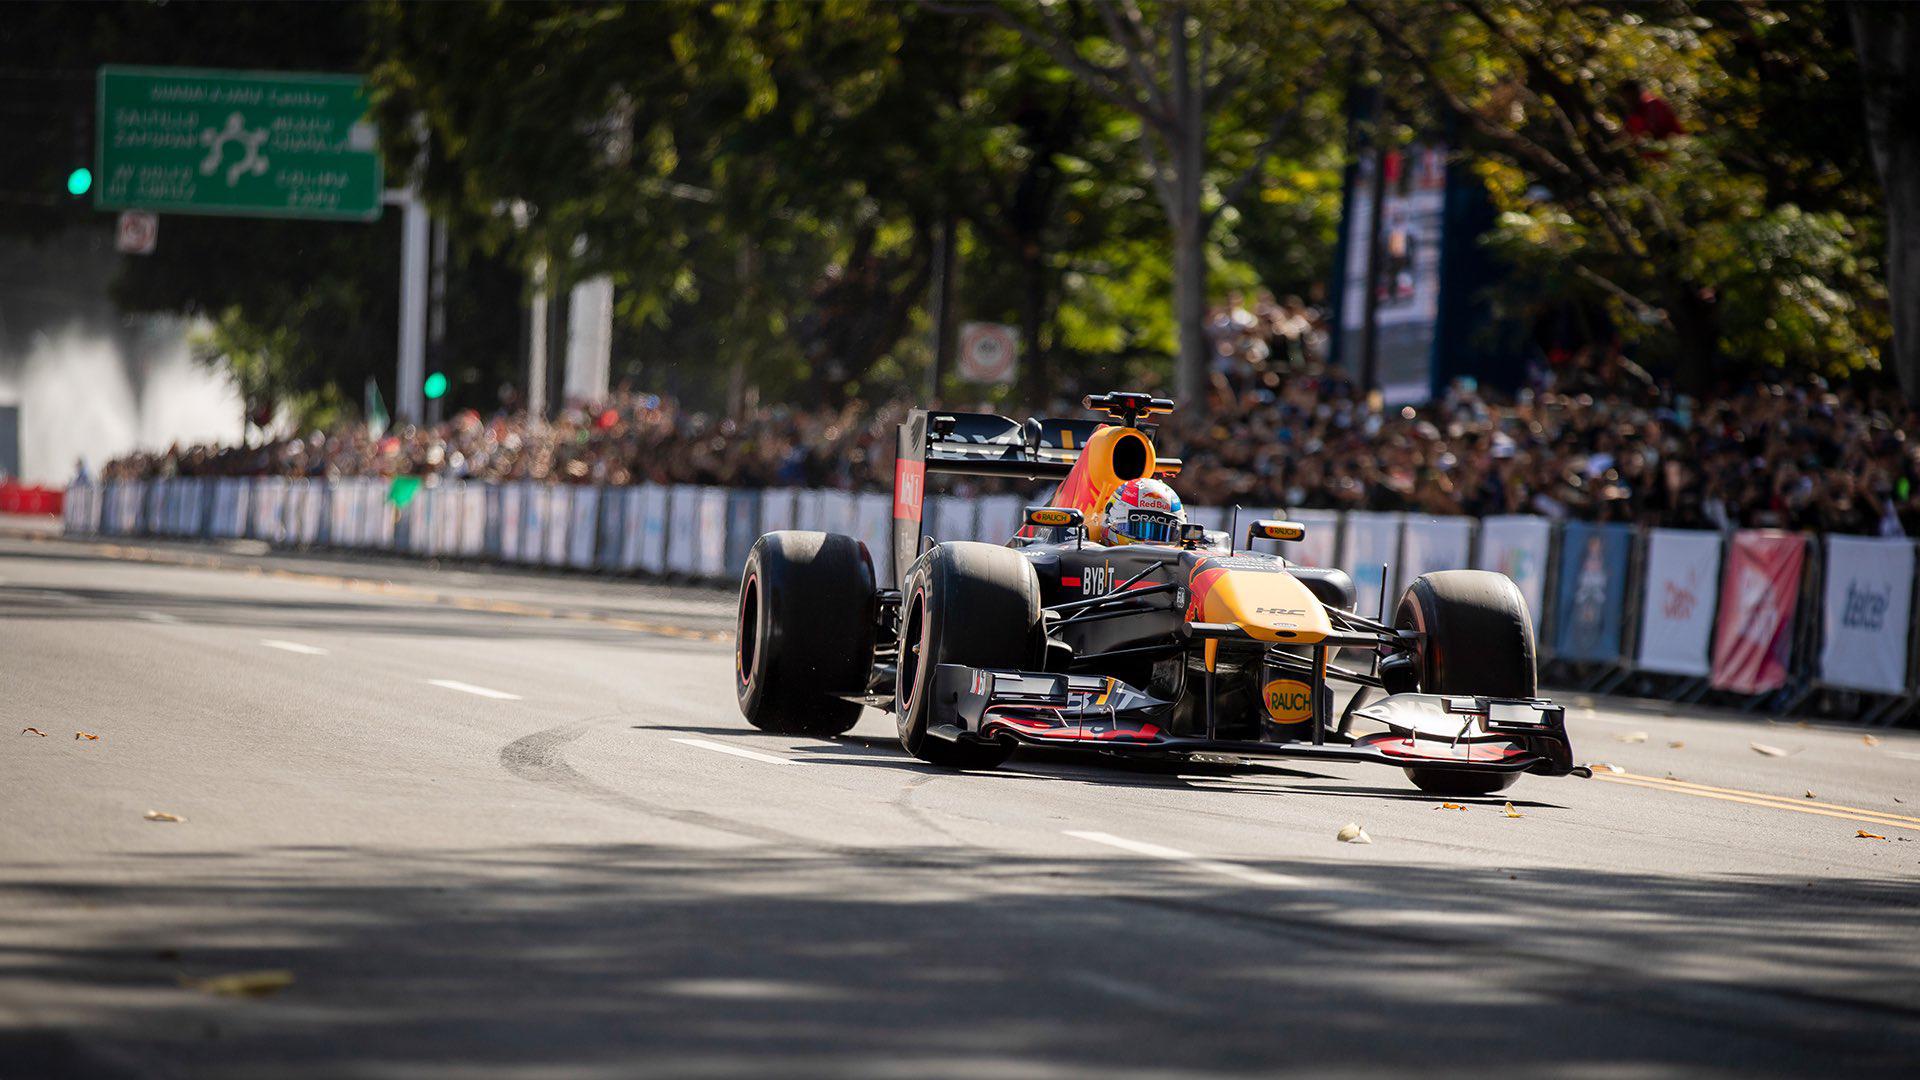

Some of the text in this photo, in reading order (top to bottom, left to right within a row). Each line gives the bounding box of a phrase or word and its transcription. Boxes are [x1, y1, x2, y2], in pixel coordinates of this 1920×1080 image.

[1140, 500, 1170, 511] Red Bull
[1042, 513, 1067, 521] RAUCH
[1130, 514, 1177, 528] ORACLE
[1274, 527, 1297, 536] RAUCH
[1083, 560, 1114, 595] BYBIT
[1256, 607, 1306, 616] HRC
[1271, 691, 1312, 711] RAUCH
